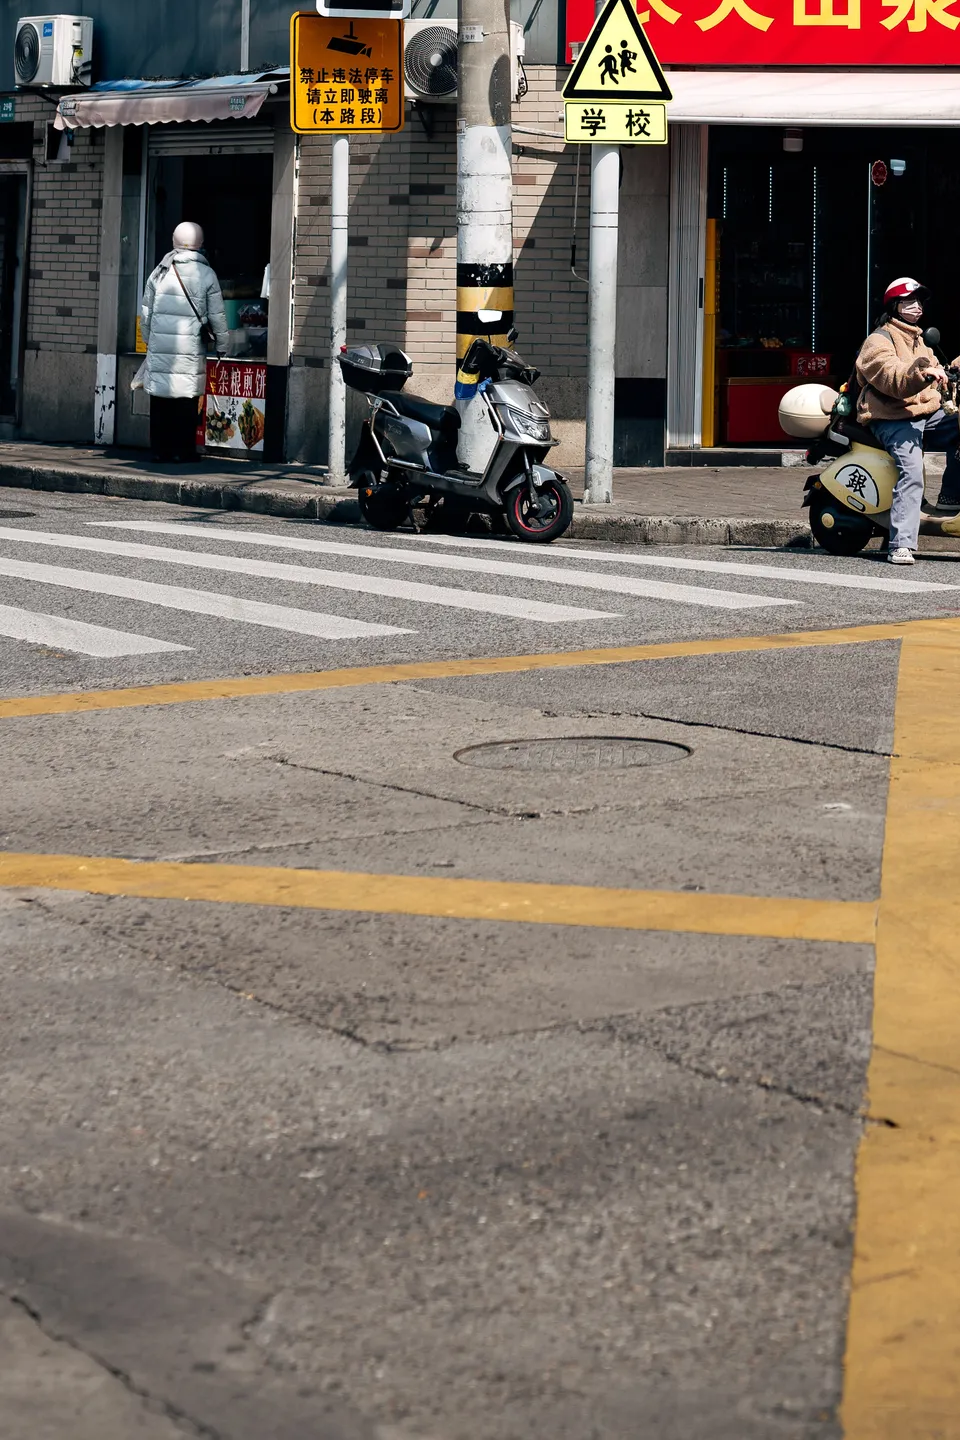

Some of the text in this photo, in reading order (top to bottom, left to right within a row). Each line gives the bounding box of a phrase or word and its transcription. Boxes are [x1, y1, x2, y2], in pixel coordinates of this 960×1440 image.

[300, 67, 394, 84] 禁止违法停车
[306, 88, 389, 105] 请立即驶离
[581, 108, 651, 137] 学校
[217, 365, 267, 399] 杂粮煎饼
[844, 467, 868, 499] 銀
